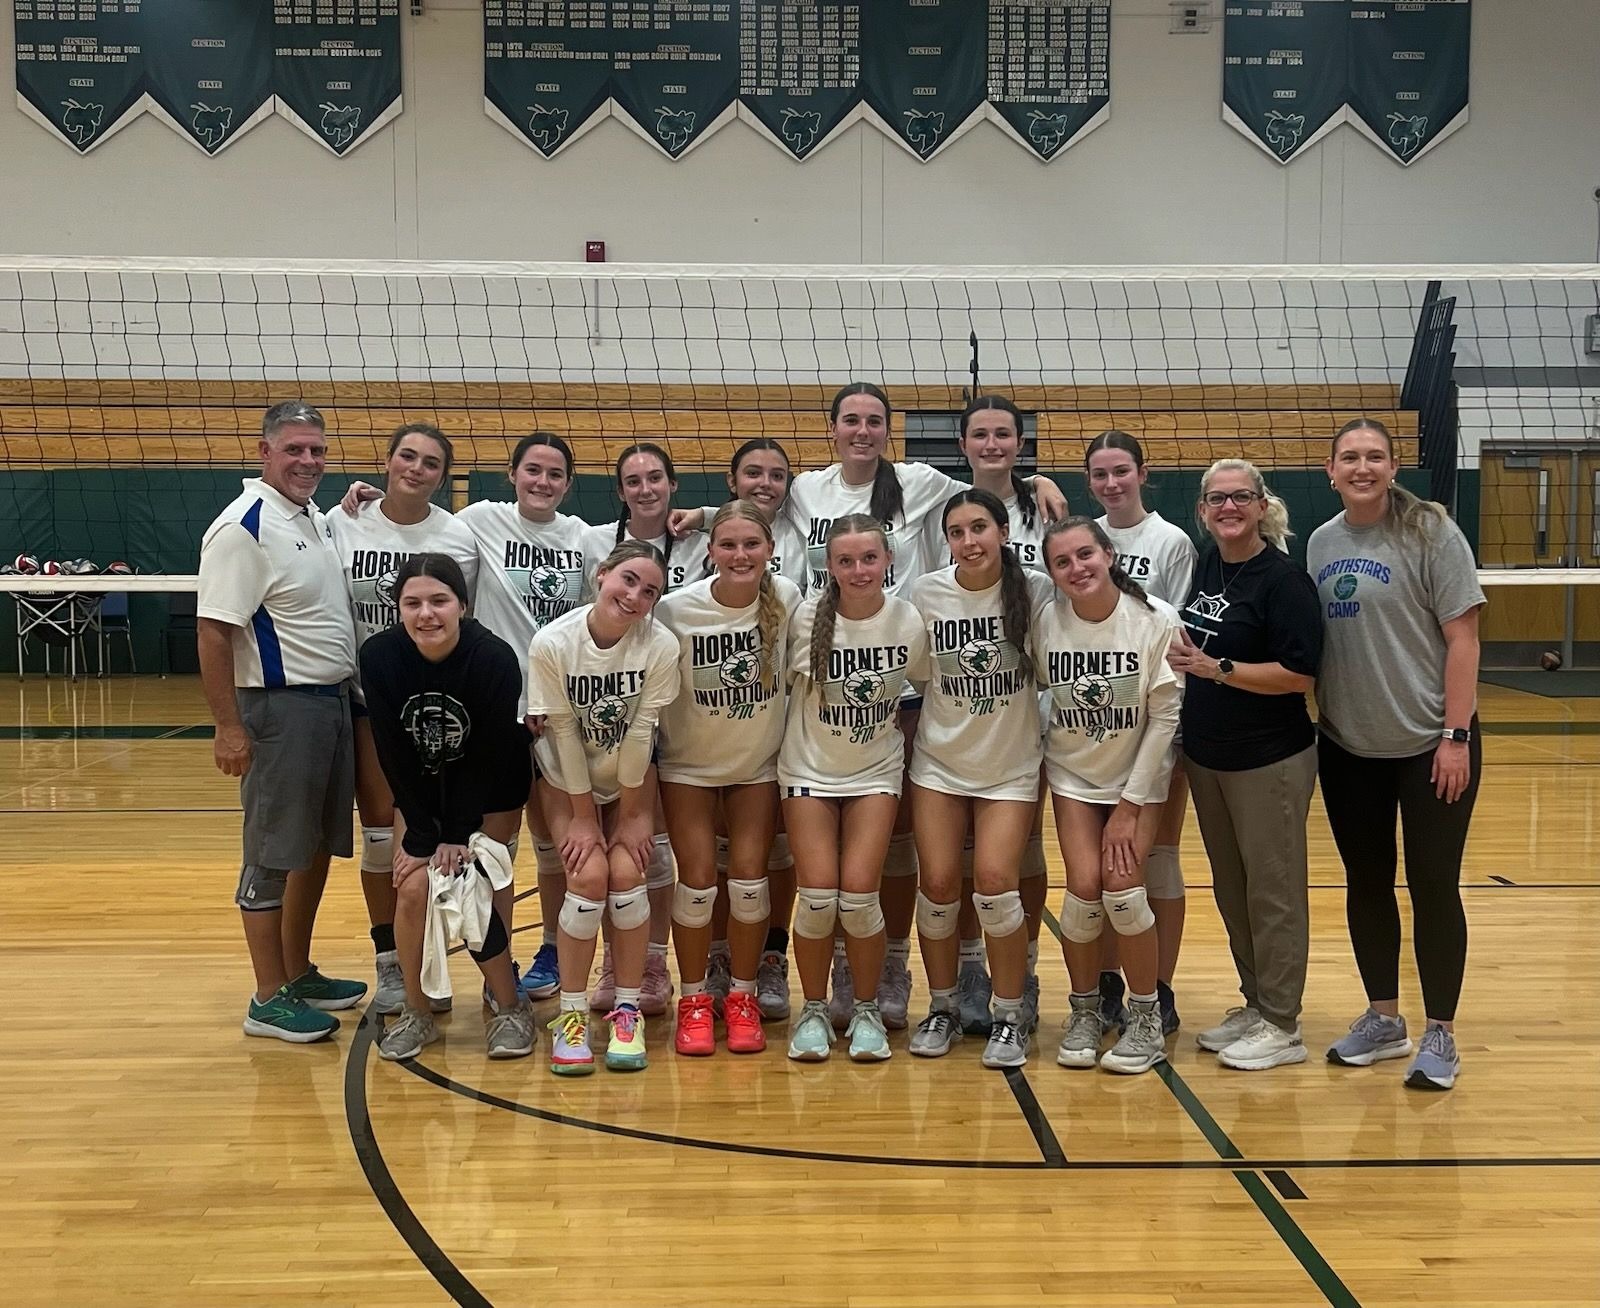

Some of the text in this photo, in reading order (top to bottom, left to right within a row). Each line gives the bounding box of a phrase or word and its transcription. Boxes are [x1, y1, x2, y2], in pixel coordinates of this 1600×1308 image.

[504, 540, 582, 569] HORNETS
[1318, 558, 1391, 584] NORTHSTARS
[1328, 602, 1360, 618] CAMP
[692, 627, 760, 666] HORNE
[934, 616, 1006, 652] HORNET
[829, 646, 908, 679] ORNETS
[1049, 652, 1139, 684] HORNETS
